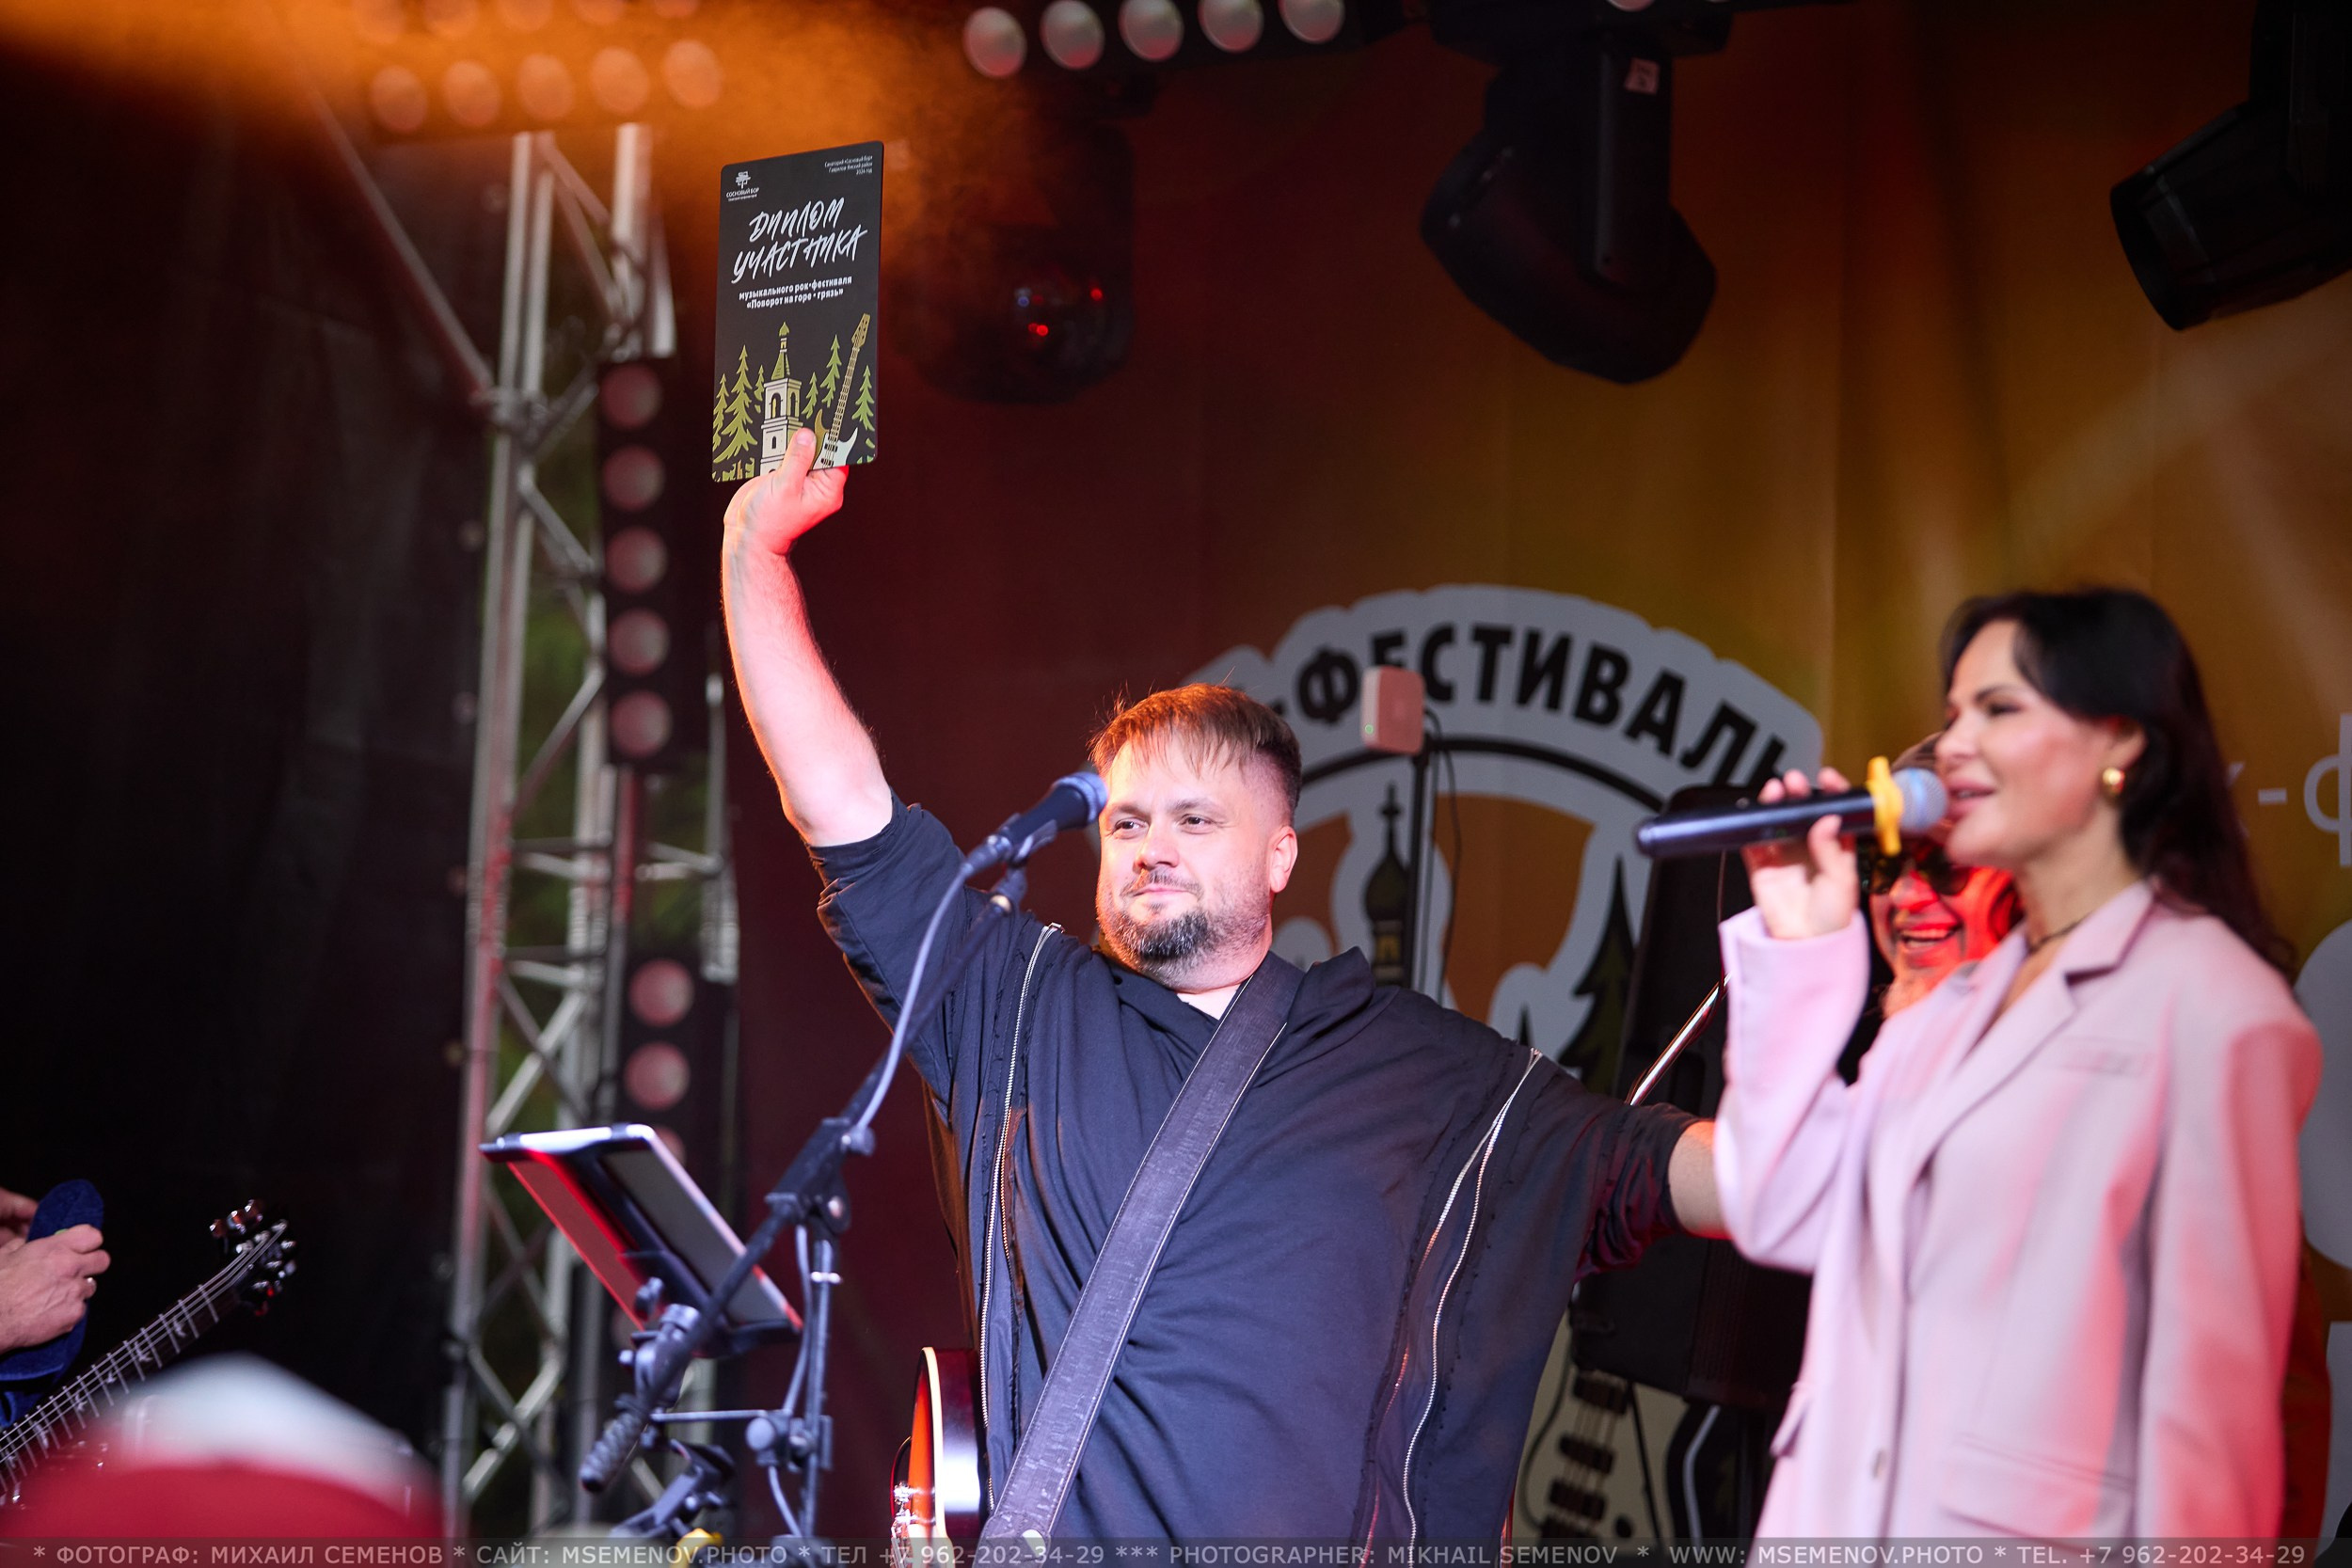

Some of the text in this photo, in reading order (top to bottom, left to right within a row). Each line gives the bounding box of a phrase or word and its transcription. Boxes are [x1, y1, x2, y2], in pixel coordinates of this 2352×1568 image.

[749, 197, 845, 243] ДИПЛОМ
[731, 224, 868, 284] УЧАСТНИКА
[739, 284, 794, 301] музыкального
[746, 296, 783, 309] «Поворот
[784, 295, 793, 305] на
[794, 292, 812, 304] горе
